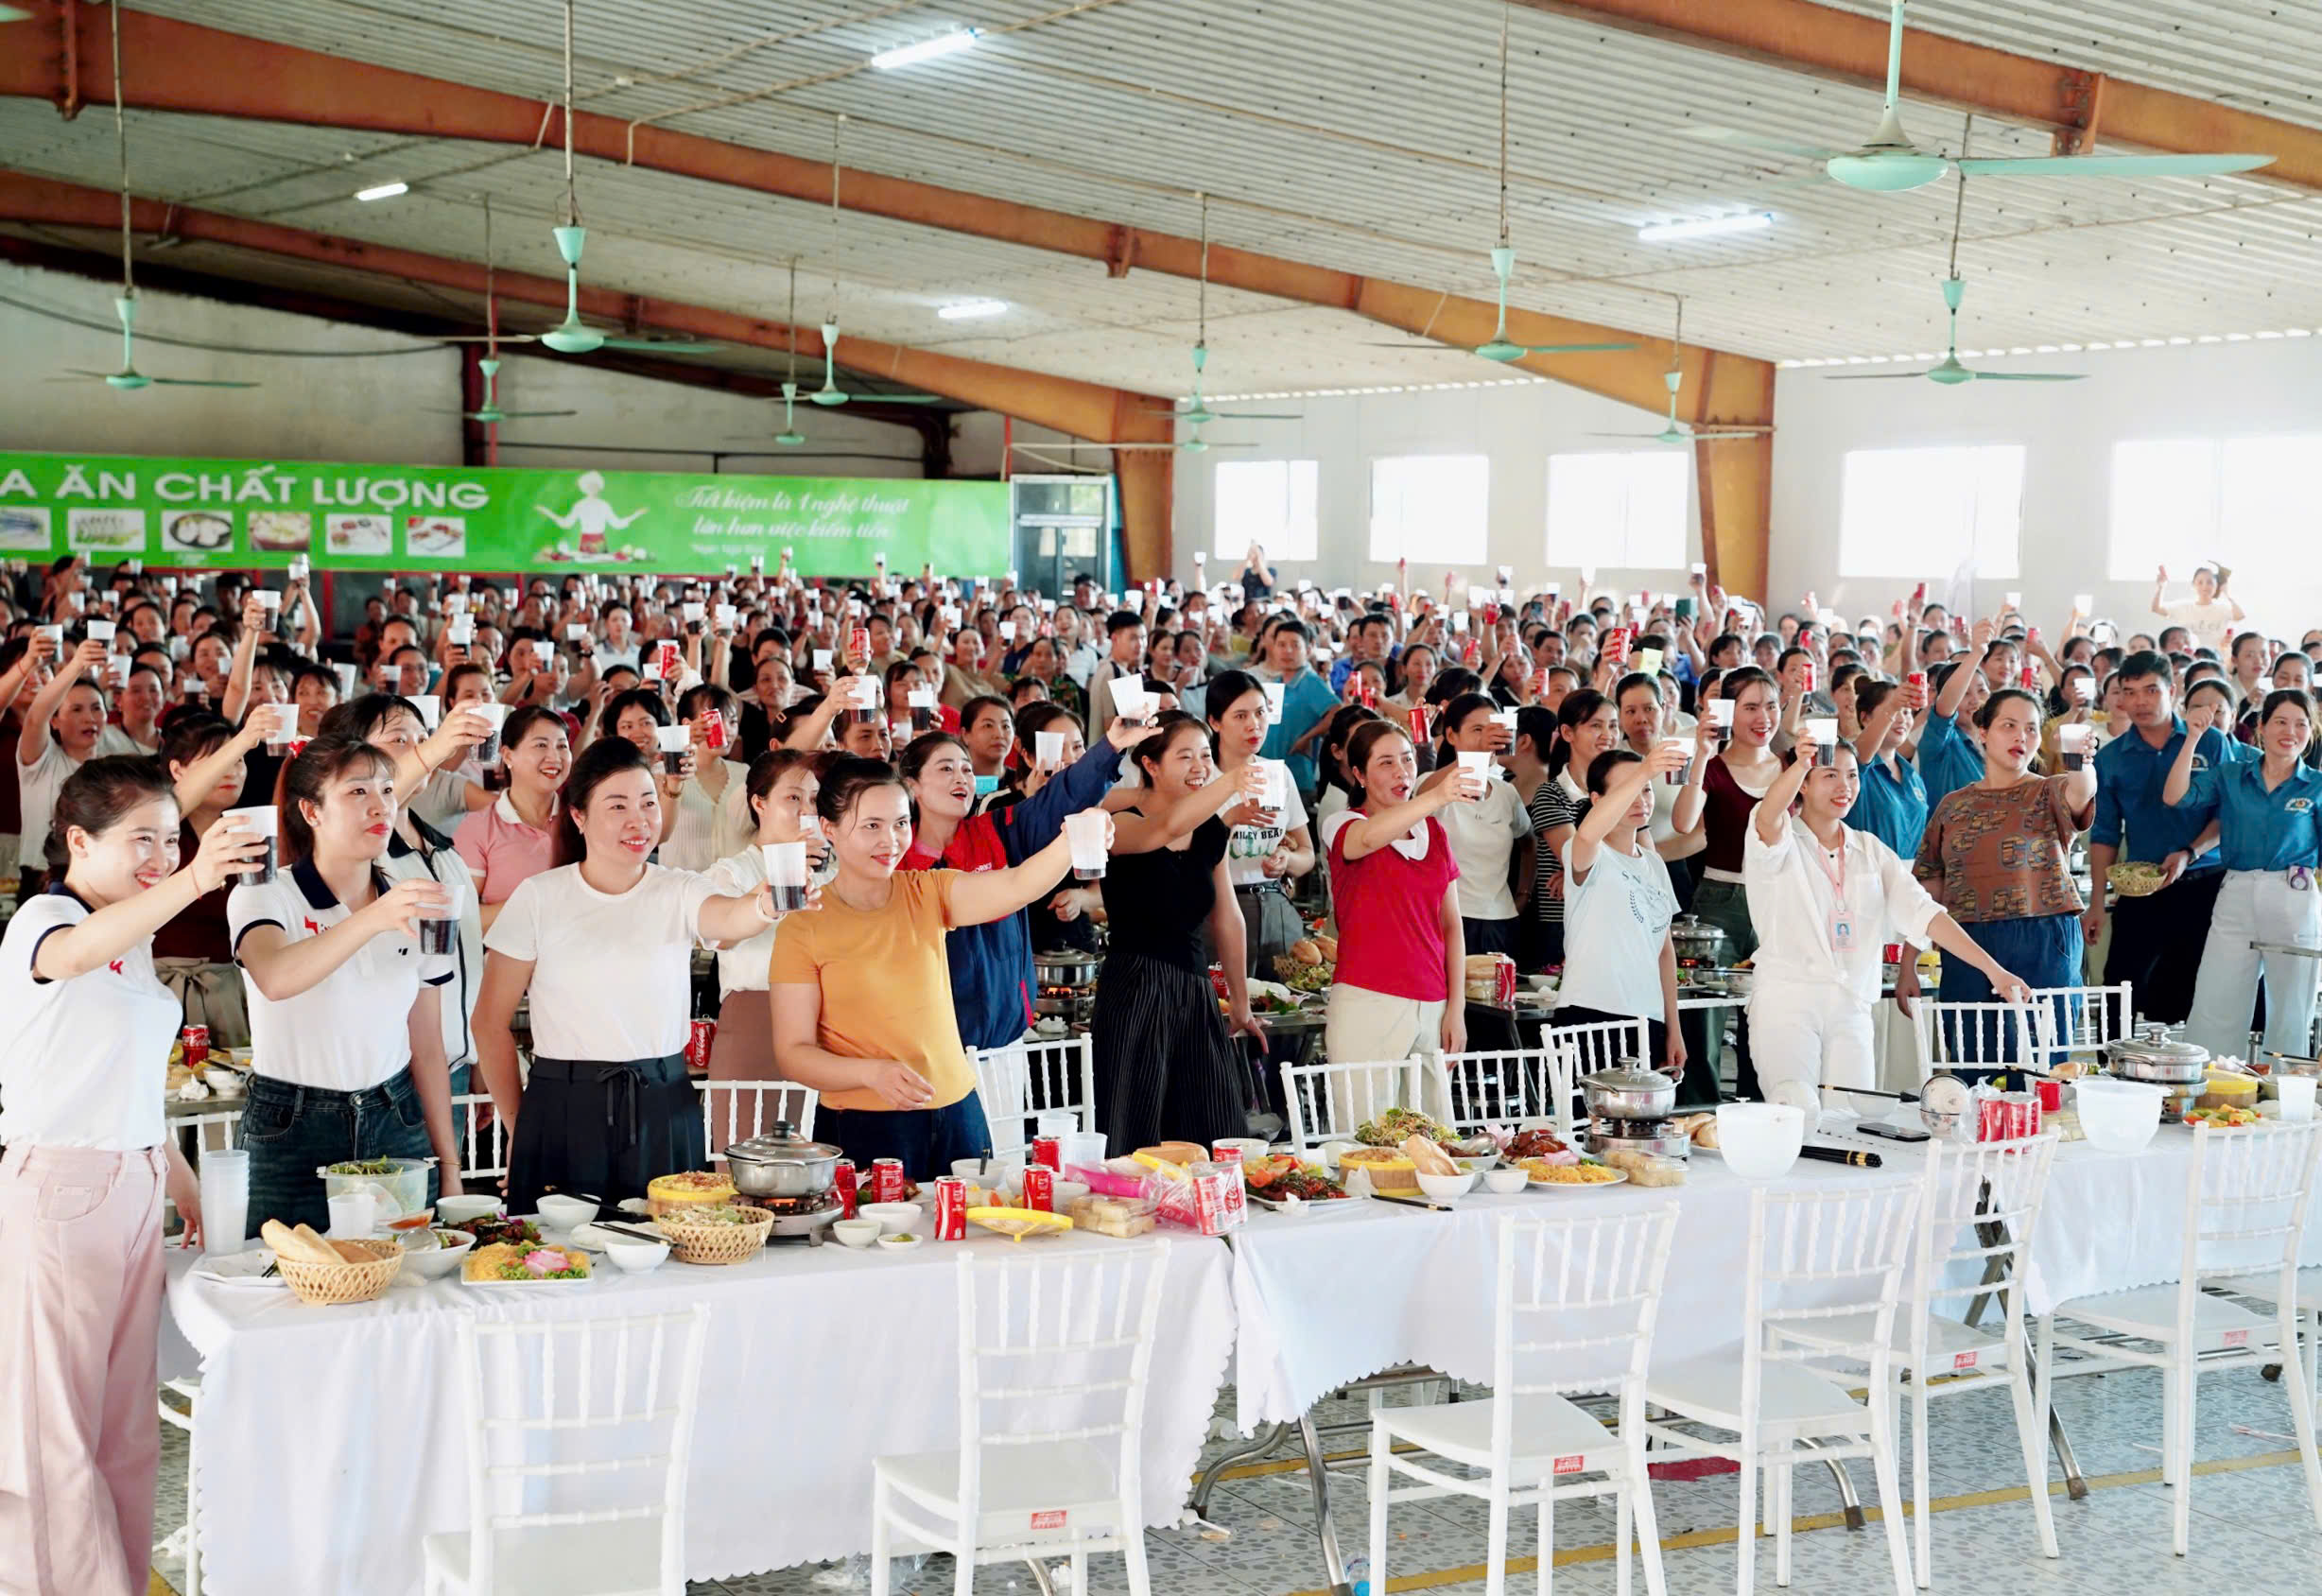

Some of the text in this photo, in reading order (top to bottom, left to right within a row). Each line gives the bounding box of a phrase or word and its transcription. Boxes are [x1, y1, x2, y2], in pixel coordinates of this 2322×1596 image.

[0, 463, 490, 513] A ĂN CHẤT LƯỢNG
